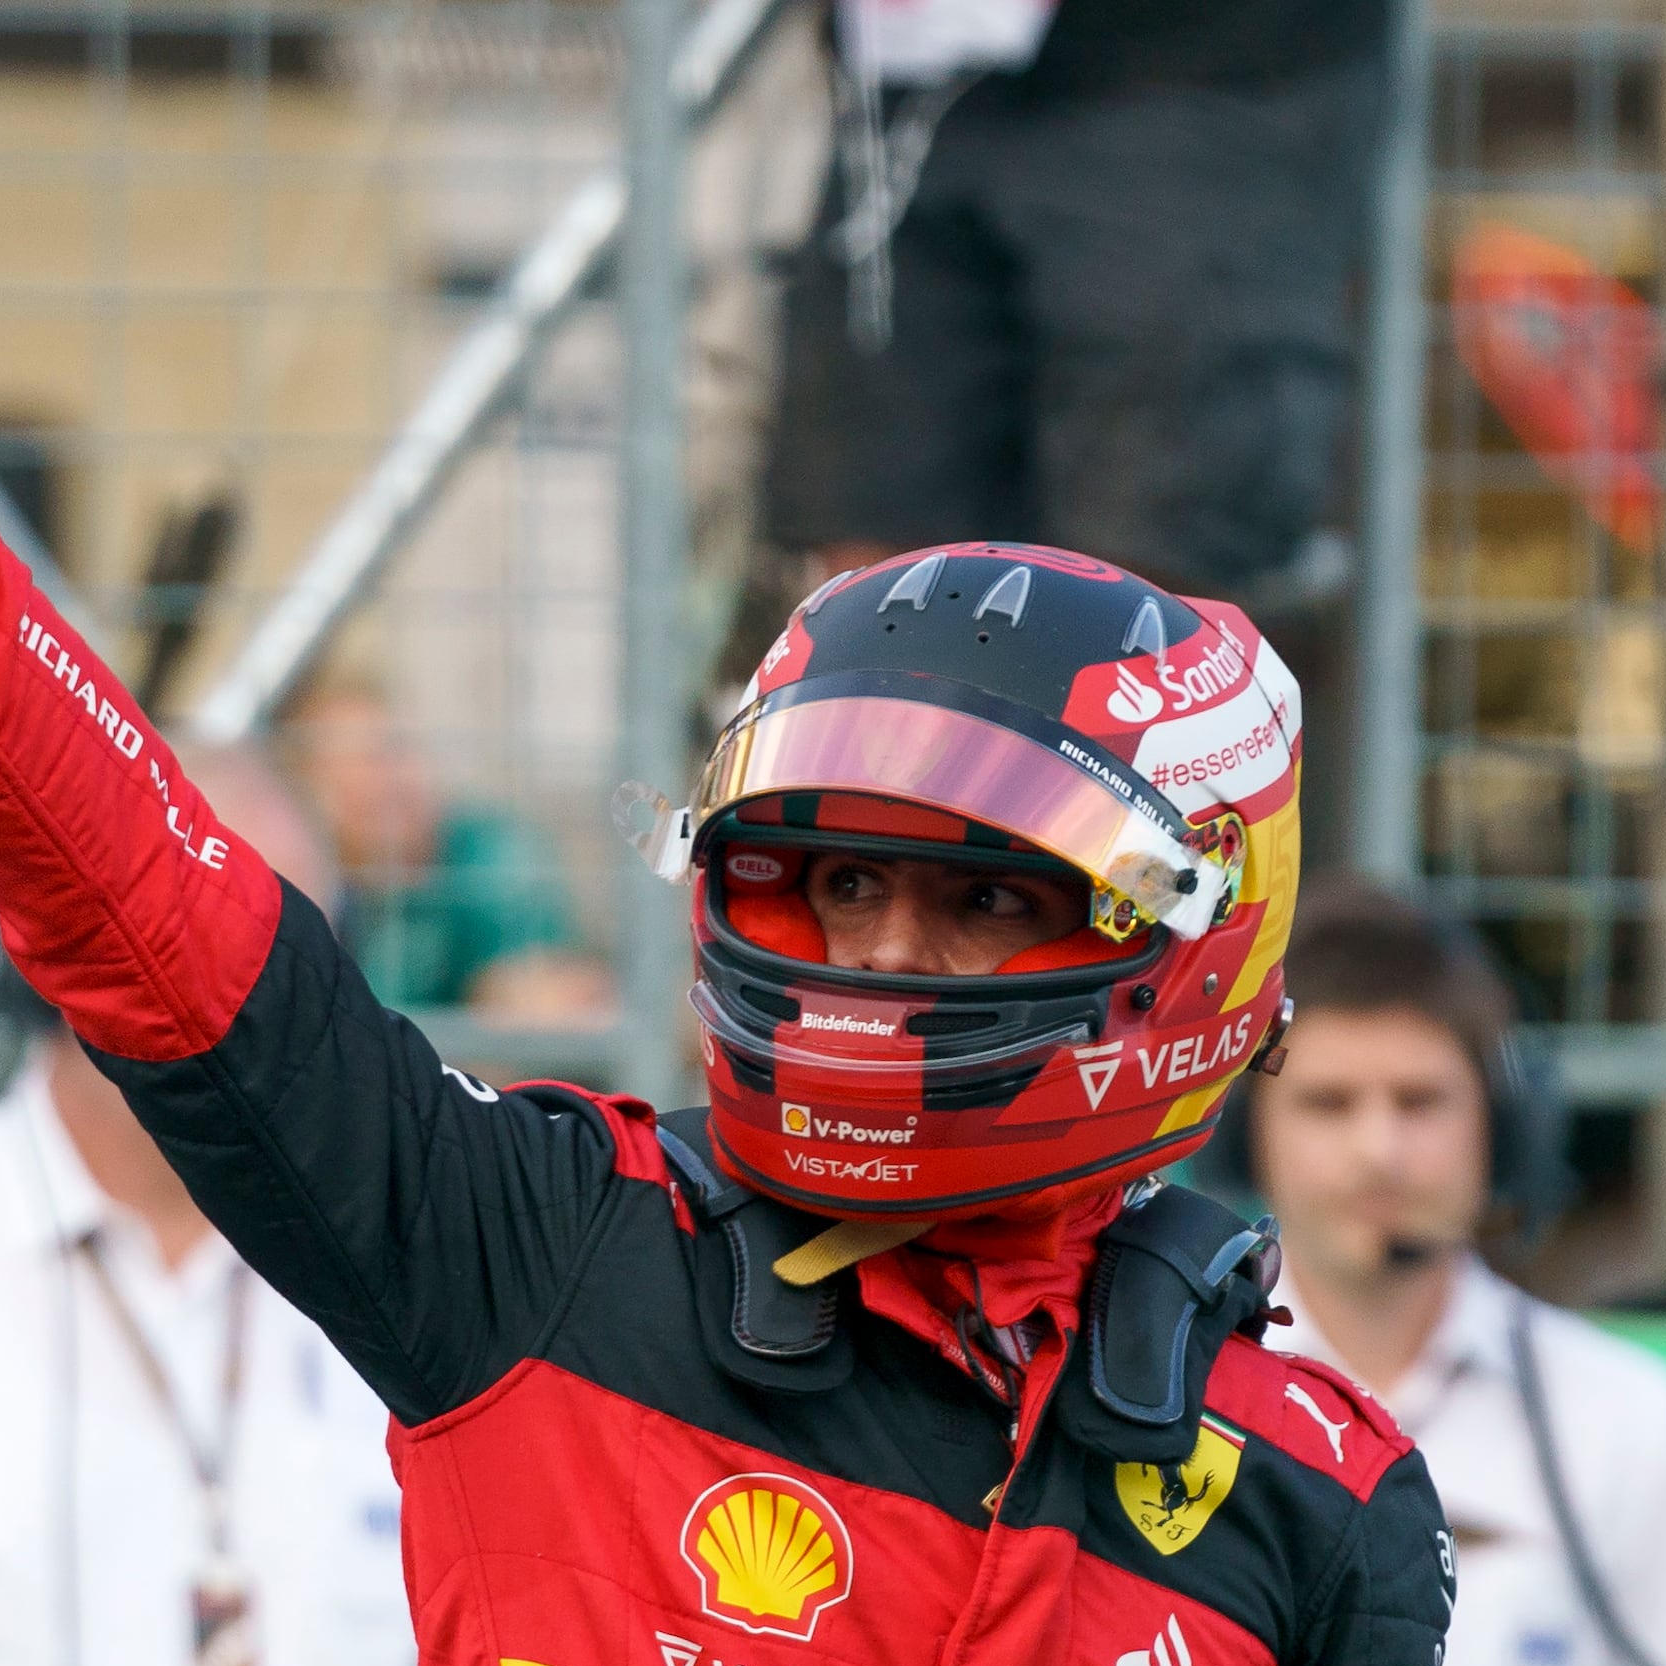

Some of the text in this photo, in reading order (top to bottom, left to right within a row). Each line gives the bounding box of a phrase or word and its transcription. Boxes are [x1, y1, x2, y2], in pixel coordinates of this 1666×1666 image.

[1059, 739, 1133, 799] RICHARD
[1133, 793, 1175, 837] MILLE
[735, 858, 776, 875] BELL
[799, 1012, 896, 1037] Bitdefender
[1136, 1012, 1253, 1090] VELAS
[813, 1117, 916, 1144] V-Power
